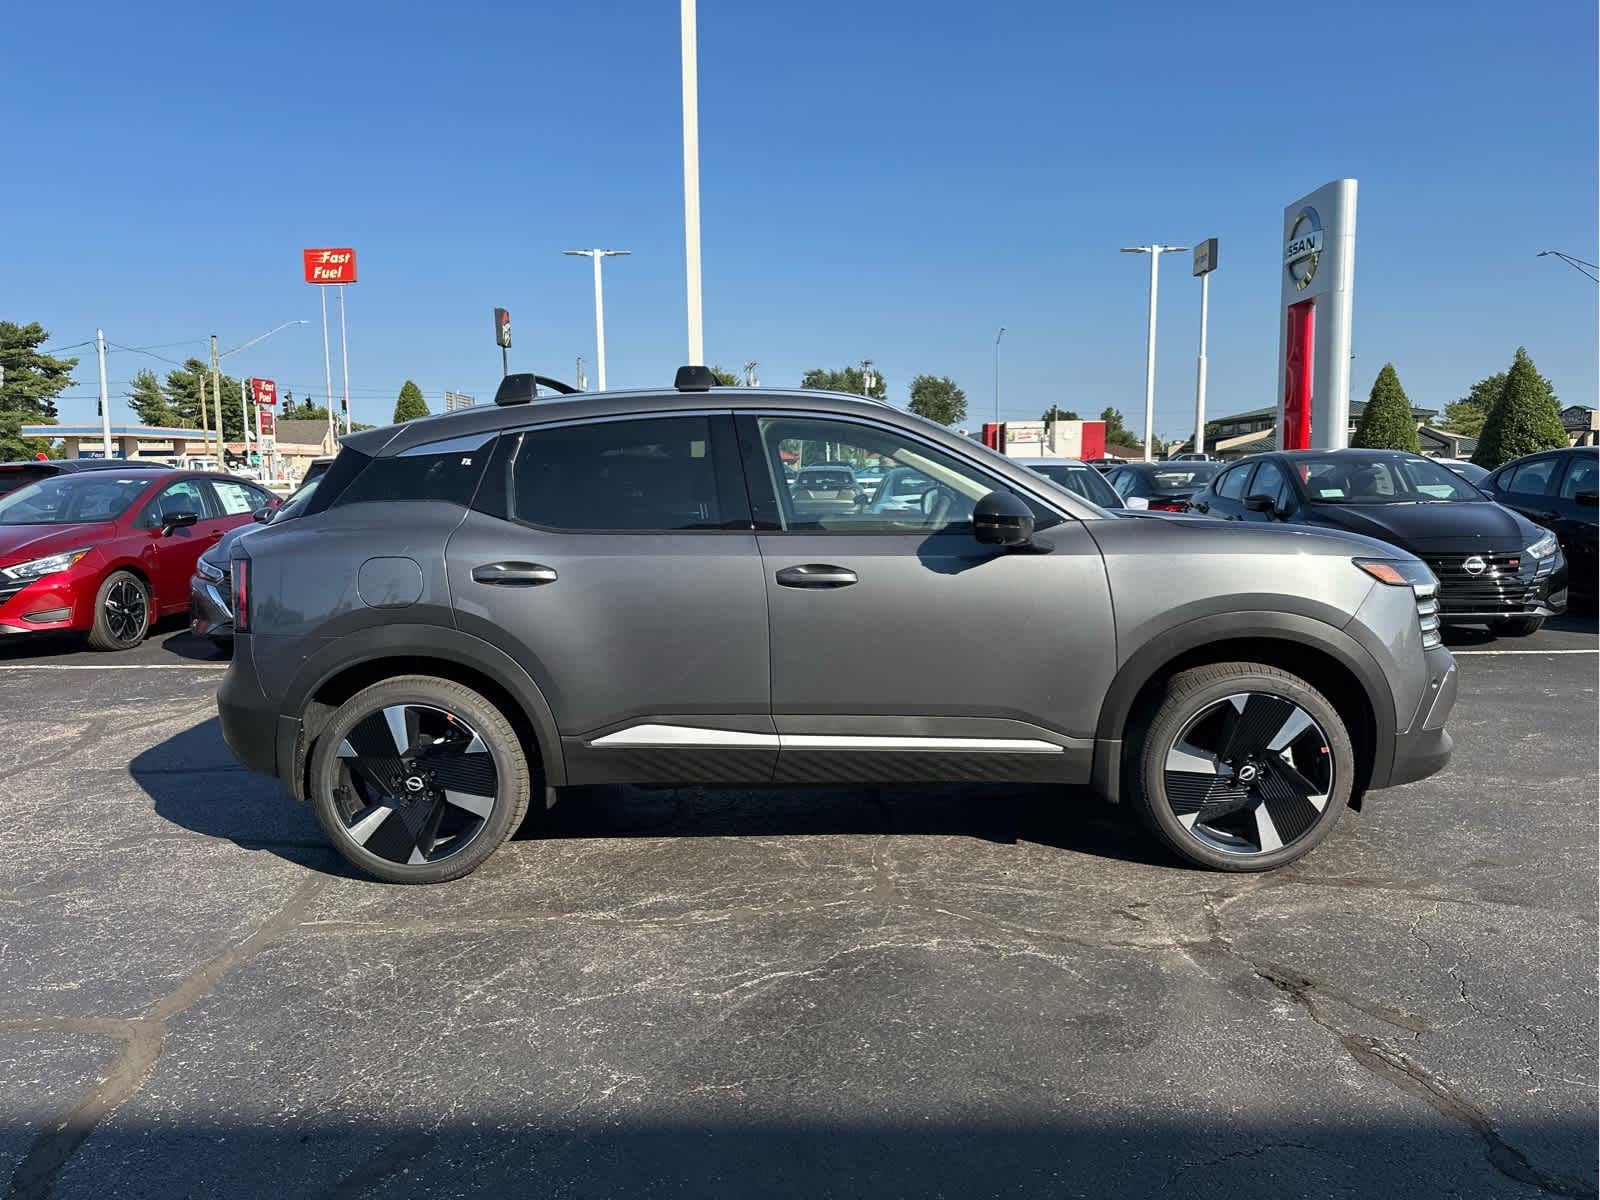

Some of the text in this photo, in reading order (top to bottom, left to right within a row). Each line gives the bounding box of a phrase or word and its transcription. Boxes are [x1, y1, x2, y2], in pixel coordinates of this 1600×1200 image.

[321, 250, 351, 264] Fast
[313, 265, 343, 279] Fuel
[261, 381, 275, 391] Fast
[258, 391, 272, 403] Fuel
